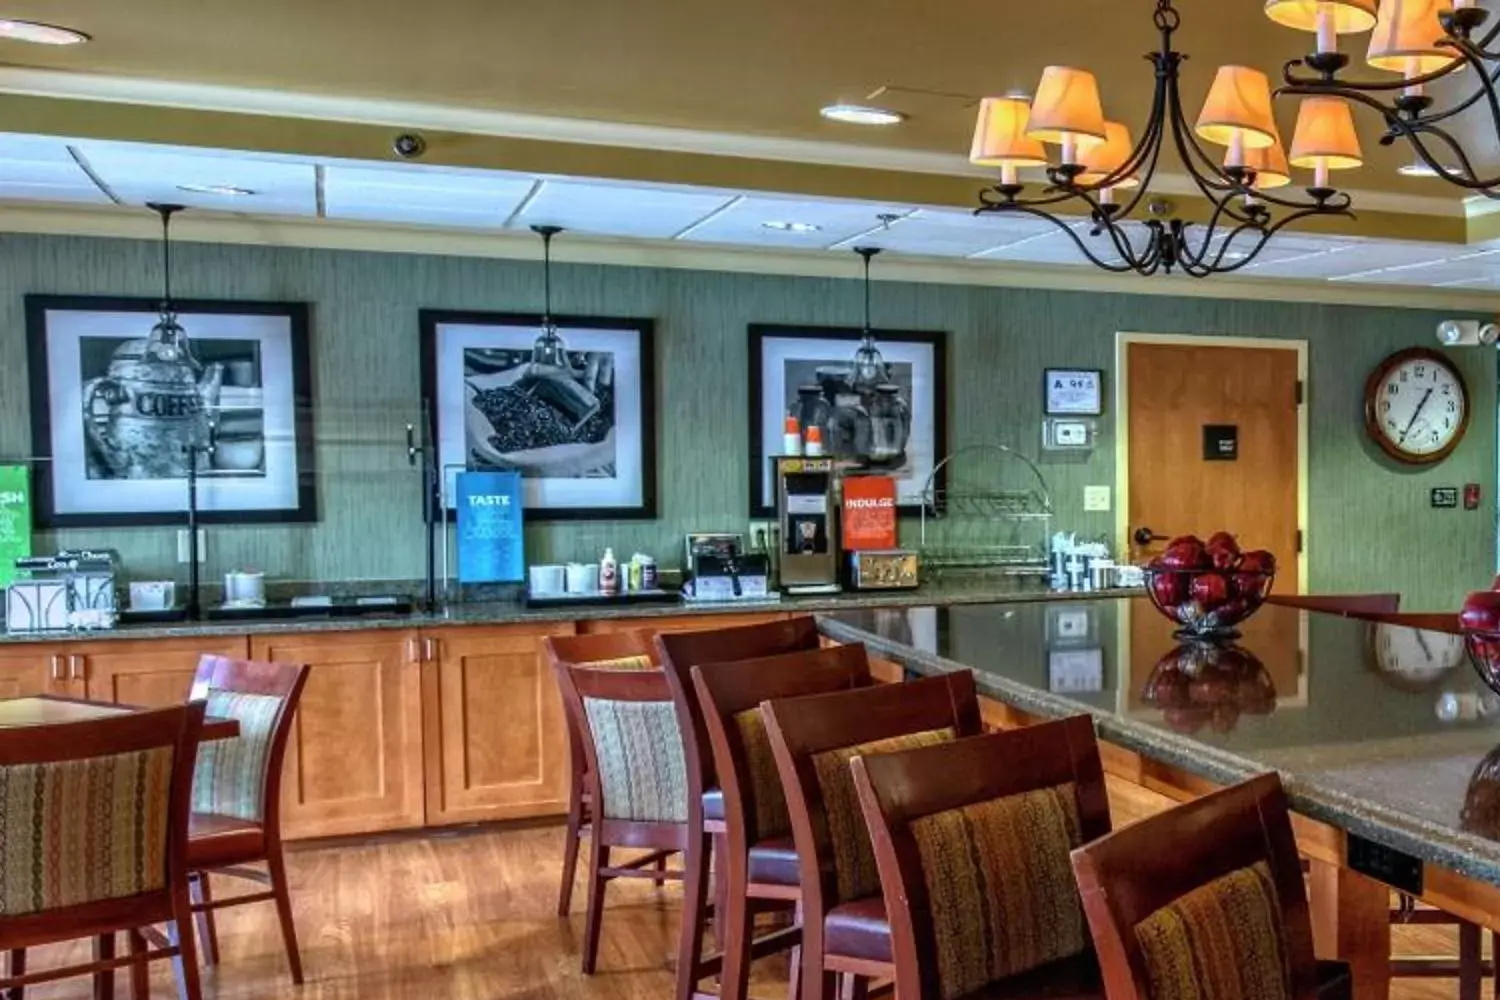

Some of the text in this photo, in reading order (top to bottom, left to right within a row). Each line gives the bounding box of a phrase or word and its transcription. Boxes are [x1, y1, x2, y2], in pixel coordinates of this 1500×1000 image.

[1414, 365, 1425, 378] 12
[467, 495, 511, 506] TASTE
[845, 498, 894, 508] INDULGE
